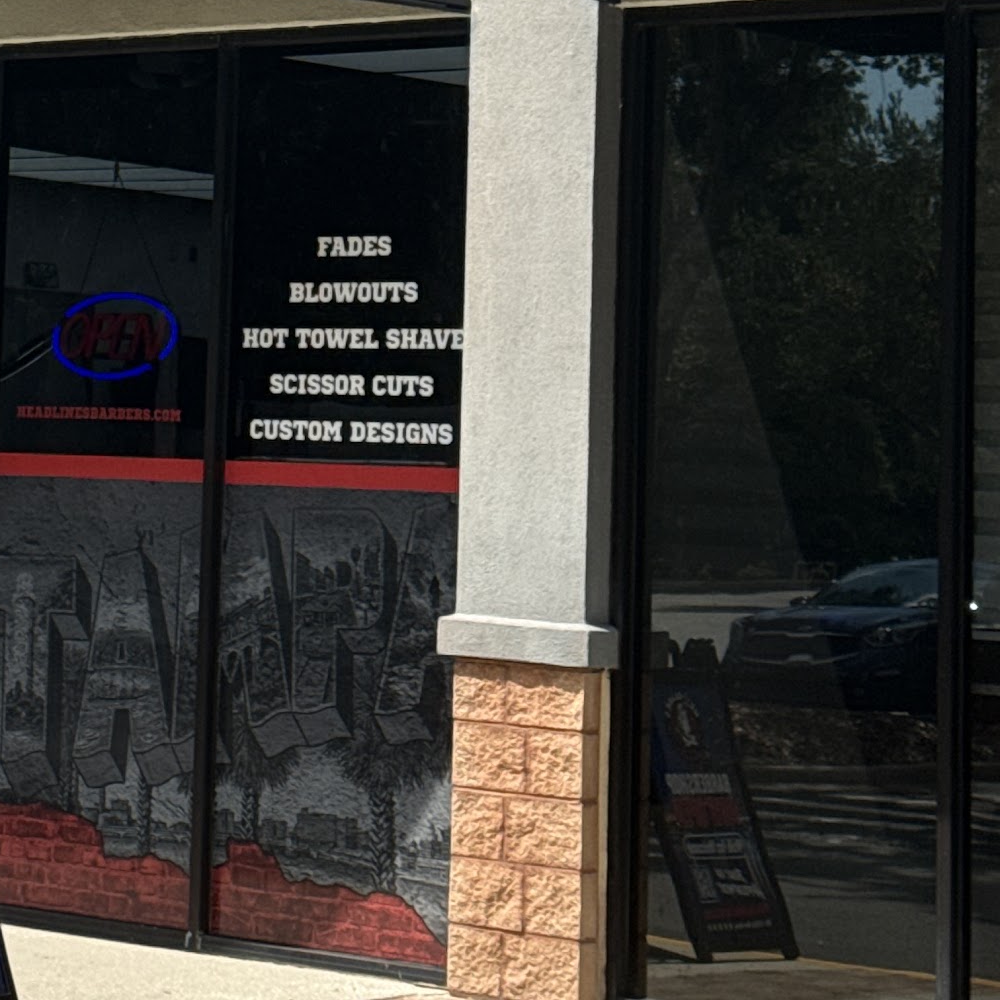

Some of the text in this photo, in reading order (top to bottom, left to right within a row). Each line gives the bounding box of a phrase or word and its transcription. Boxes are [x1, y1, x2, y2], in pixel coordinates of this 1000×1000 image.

[317, 235, 393, 258] FADES
[289, 281, 419, 303] BLOWOUTS
[61, 312, 168, 361] OPEN
[242, 328, 289, 349] HOT
[294, 328, 380, 350] TOWEL
[269, 373, 435, 398] SCISSOR CUTS
[16, 405, 182, 423] HEADLINESBARBERS.COM
[250, 418, 454, 446] CUSTOM DESIGNS
